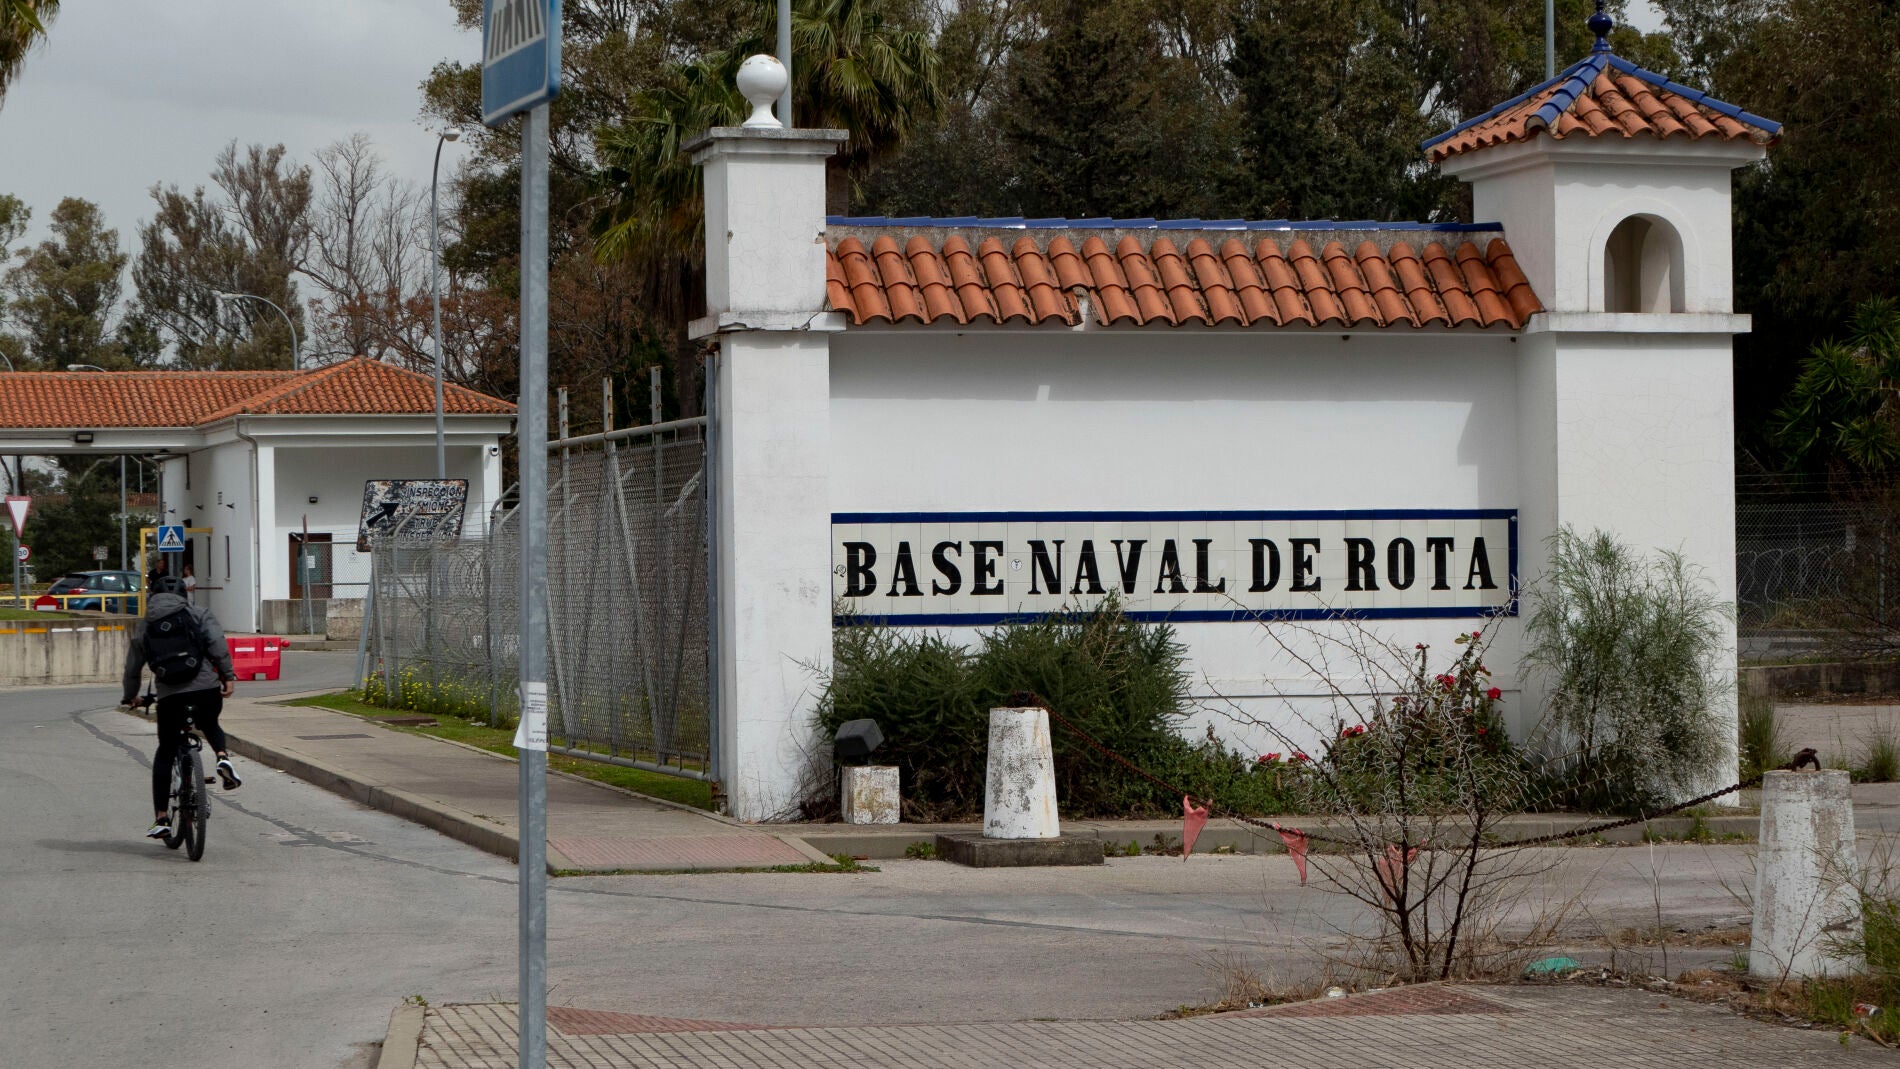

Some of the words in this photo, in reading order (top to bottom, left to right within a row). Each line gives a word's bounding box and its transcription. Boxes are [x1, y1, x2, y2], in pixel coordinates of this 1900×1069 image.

[399, 531, 454, 541] INSPECION
[842, 540, 1004, 597] BASE
[1027, 538, 1225, 595] NAVAL
[1248, 537, 1321, 592] DE
[1343, 536, 1498, 592] ROTA
